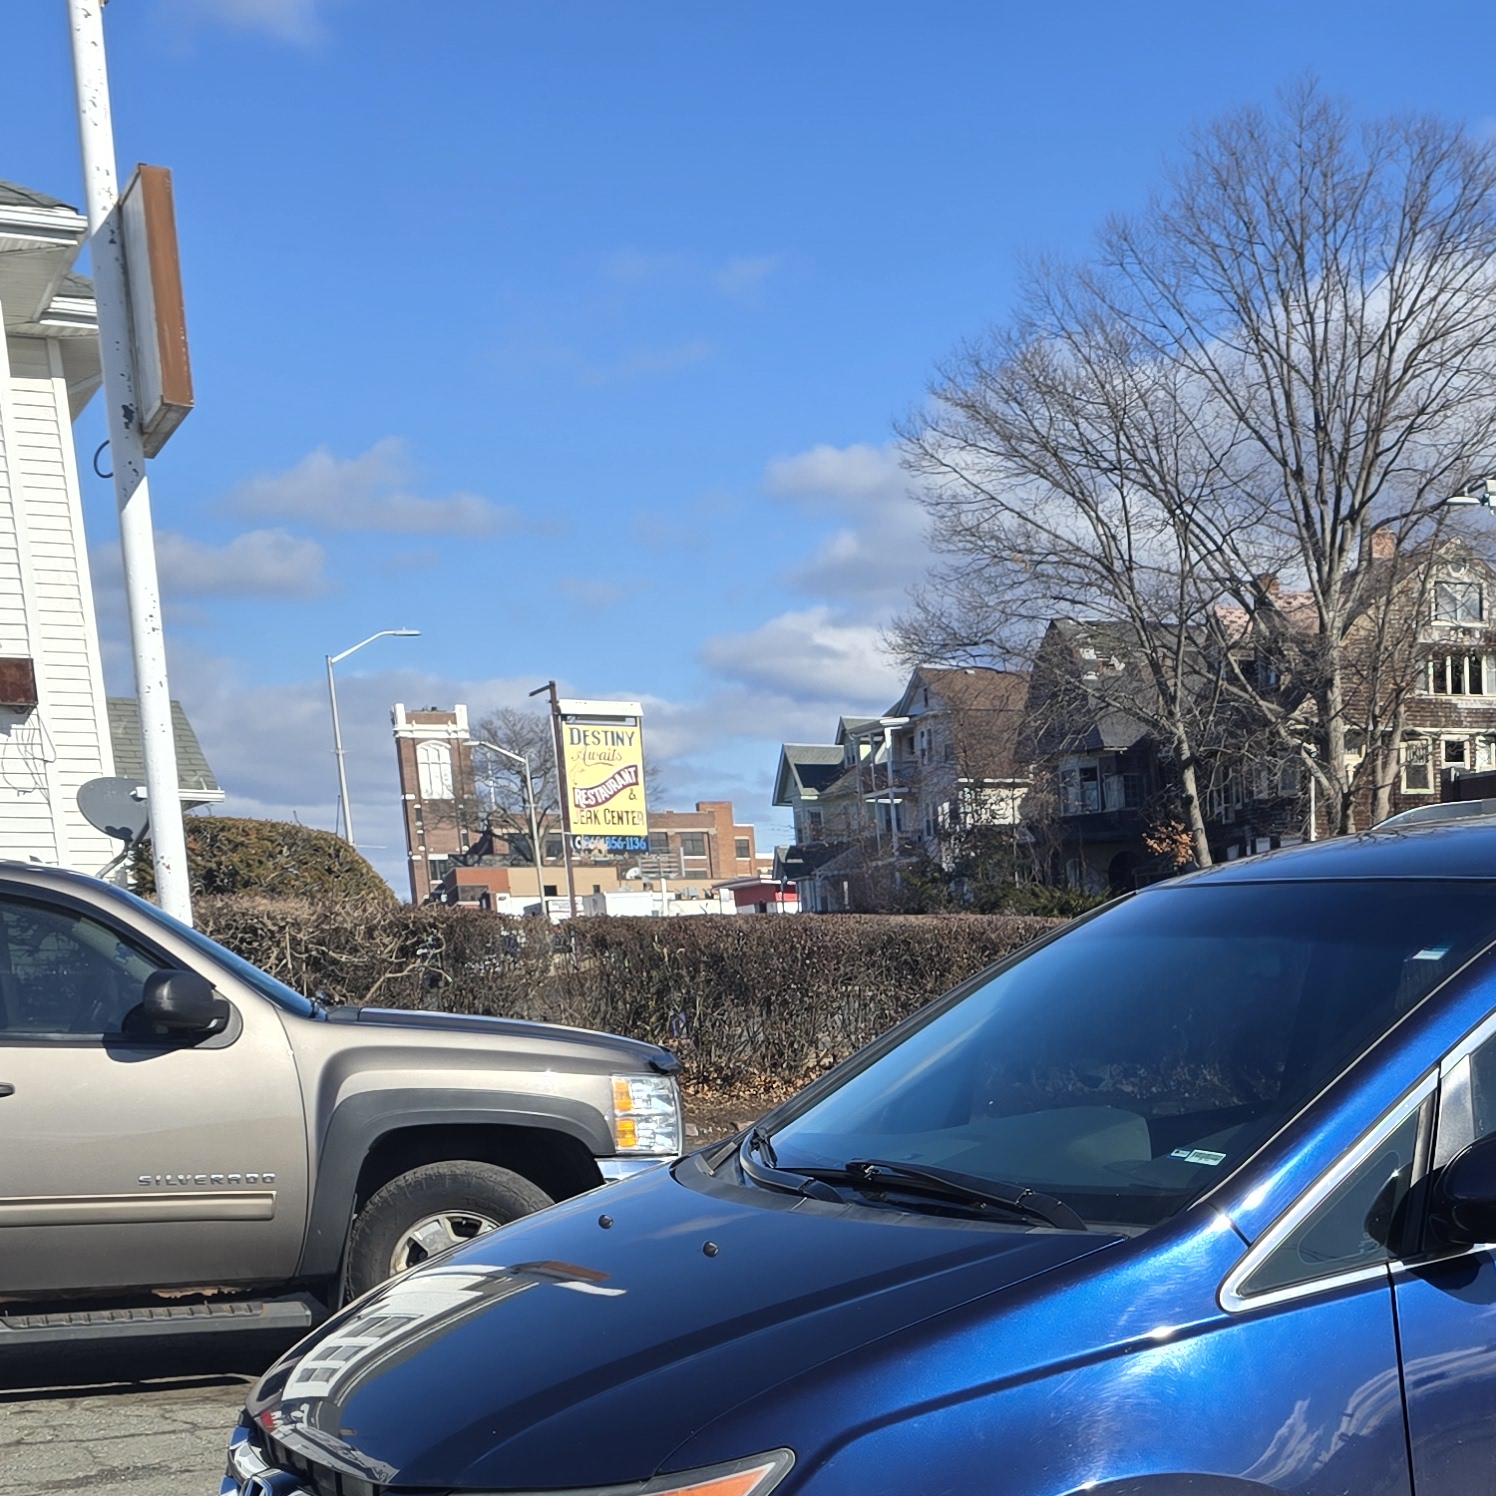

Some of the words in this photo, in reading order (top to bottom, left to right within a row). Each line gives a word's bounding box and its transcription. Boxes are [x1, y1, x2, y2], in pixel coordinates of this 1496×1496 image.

[569, 727, 635, 747] DESTINY
[571, 747, 623, 766] Awaits
[575, 767, 637, 808] RESTAURANT
[628, 788, 638, 800] &
[573, 809, 601, 826] JERK
[604, 808, 645, 826] CENTER
[138, 1173, 276, 1187] SILVERADO
